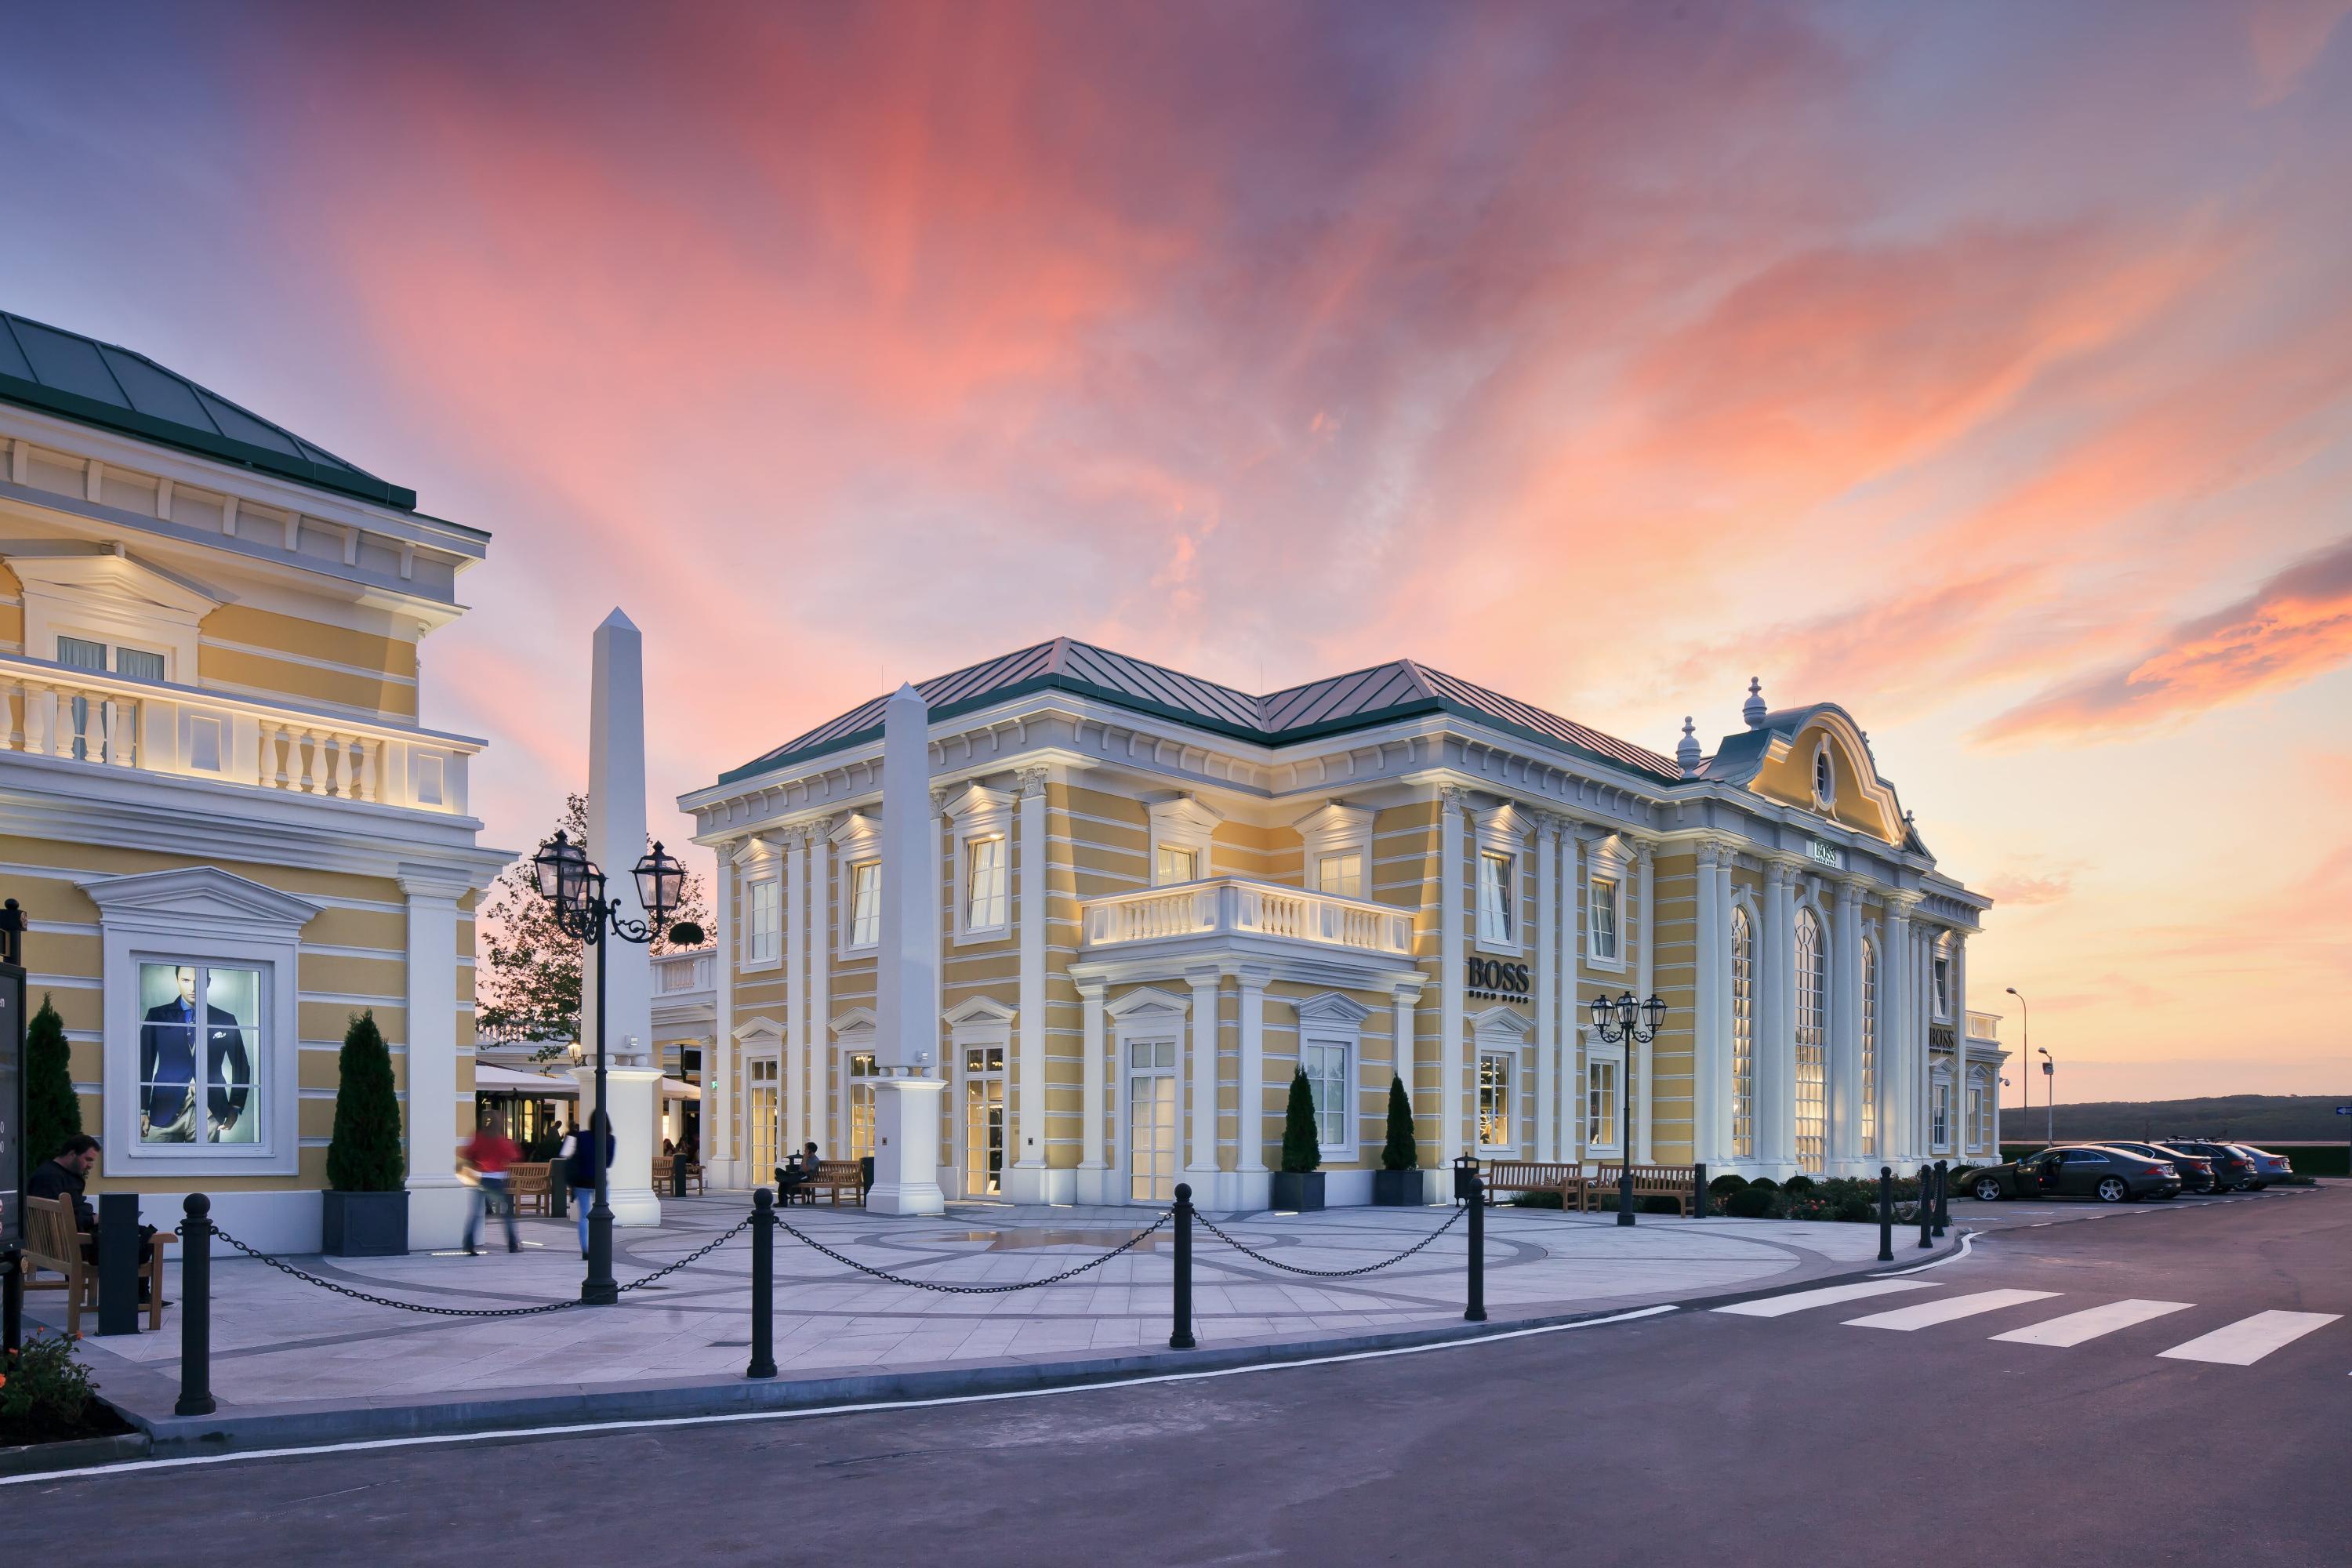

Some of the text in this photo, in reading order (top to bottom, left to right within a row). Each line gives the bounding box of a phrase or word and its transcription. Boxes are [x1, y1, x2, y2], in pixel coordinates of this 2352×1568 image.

[1469, 957, 1530, 993] BOSS
[1469, 990, 1529, 1004] HUGO BOSS
[1929, 1027, 1954, 1048] BOSS
